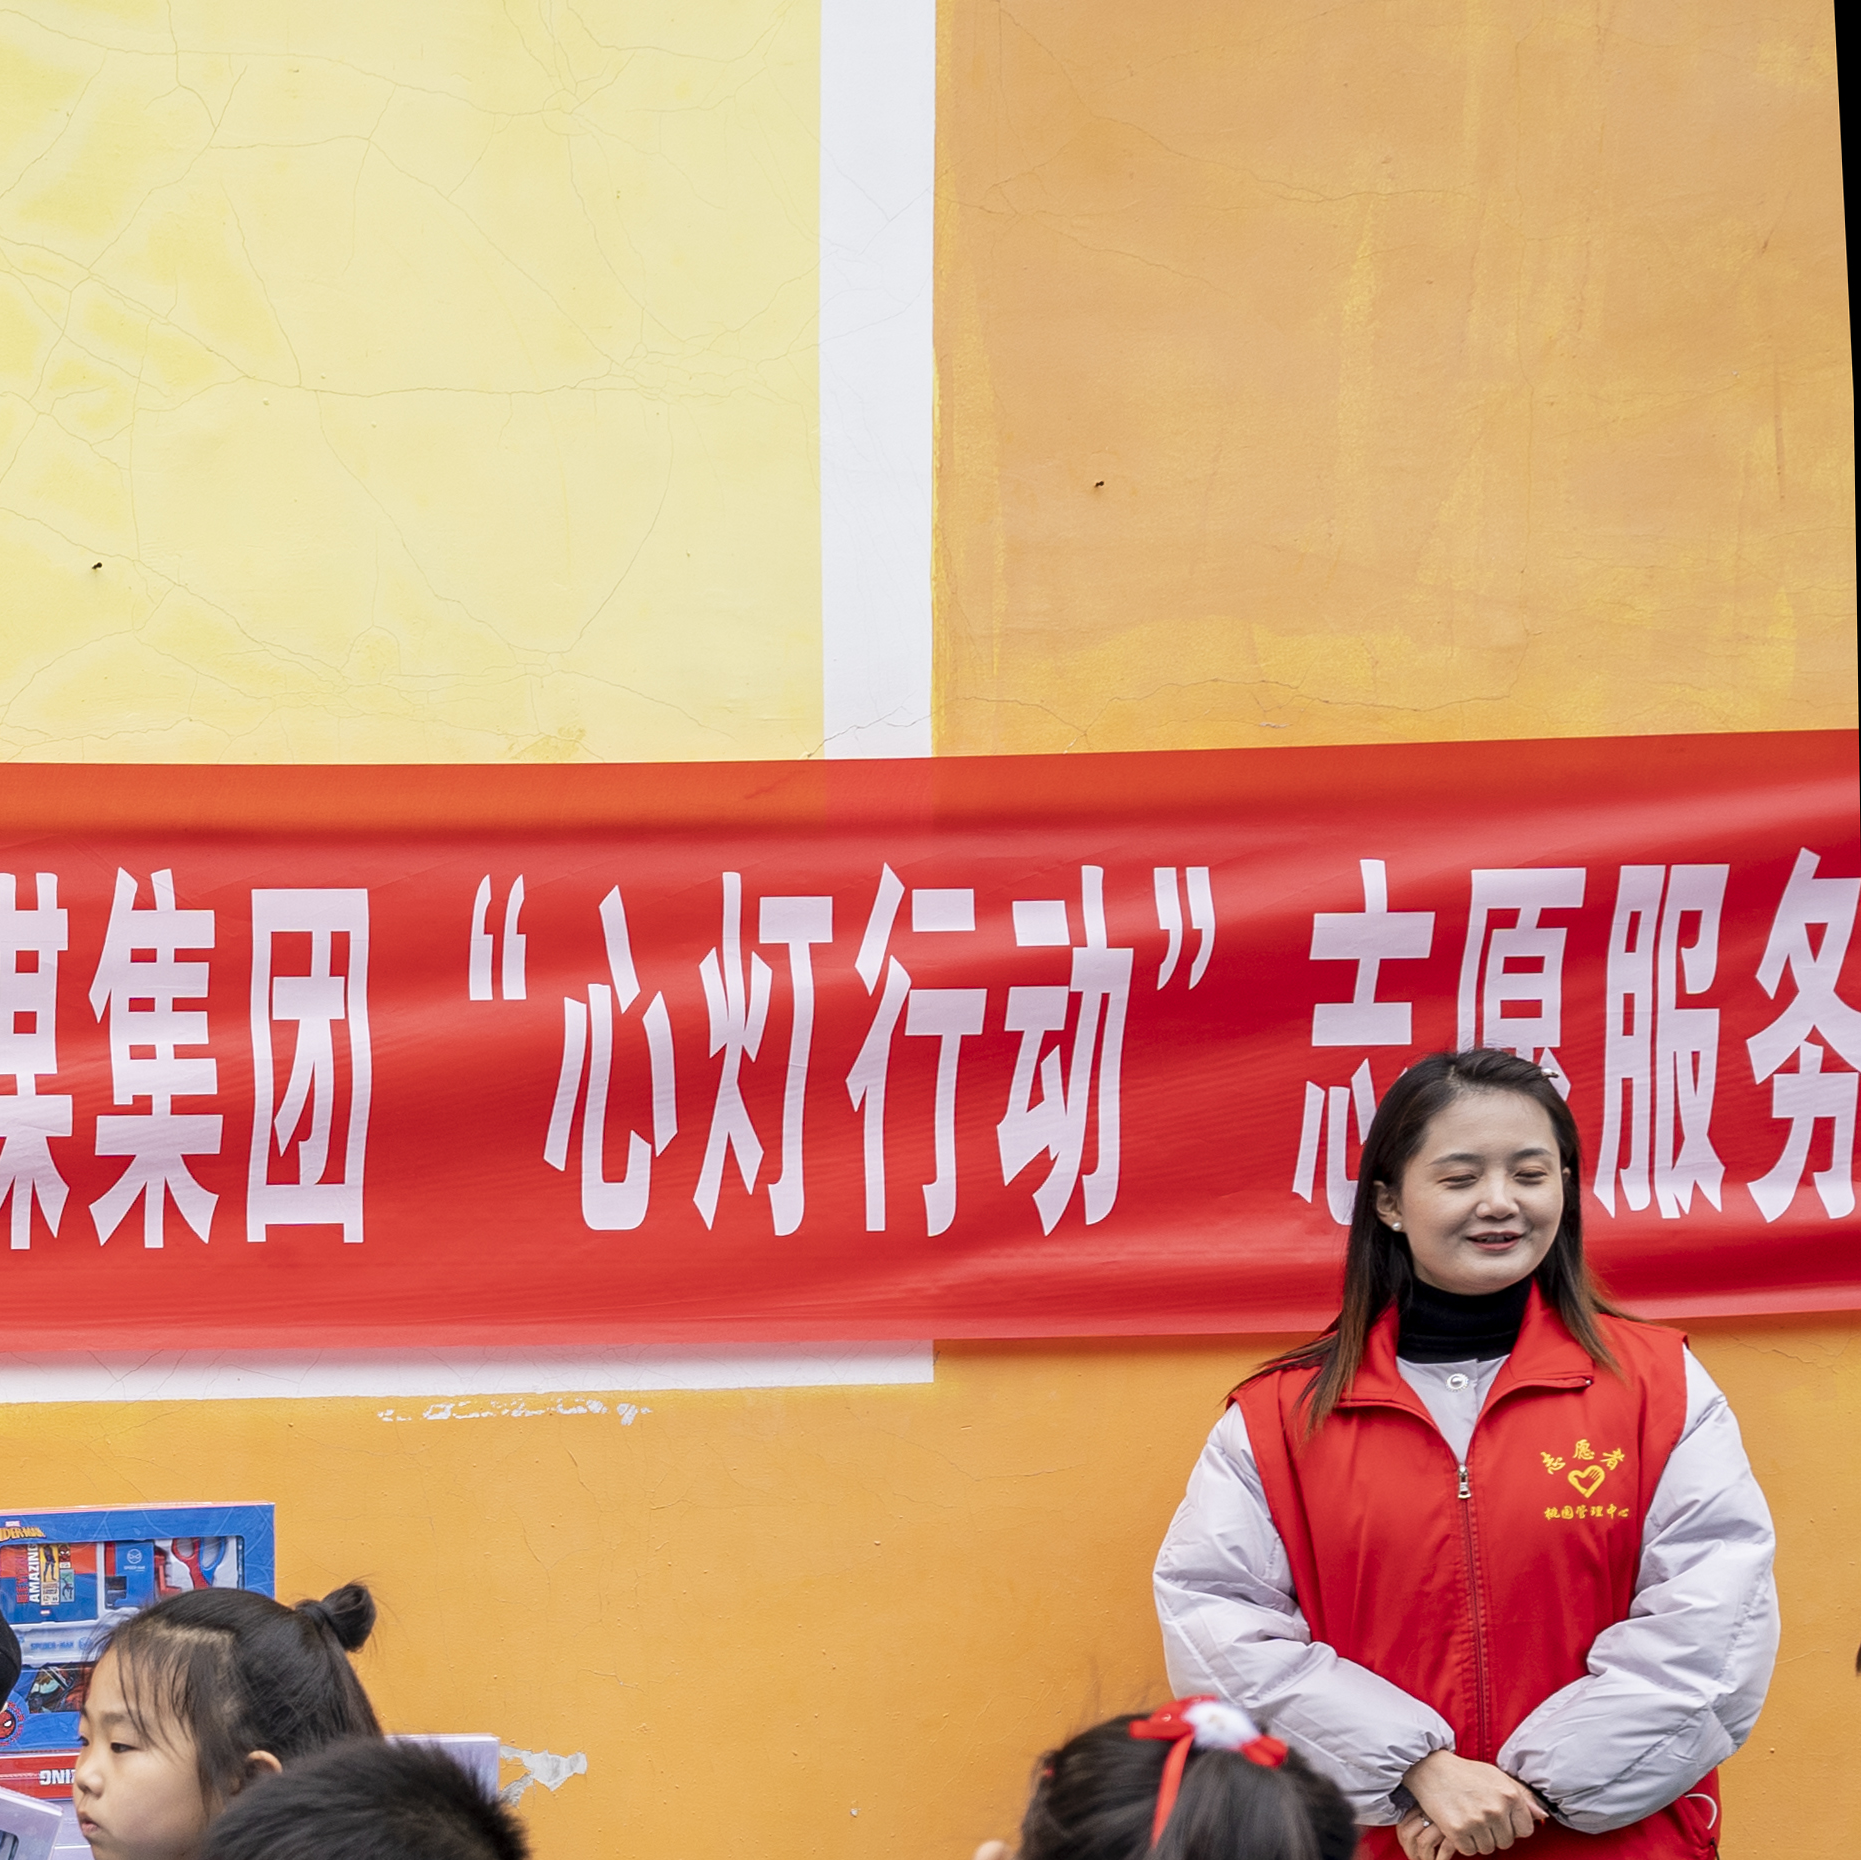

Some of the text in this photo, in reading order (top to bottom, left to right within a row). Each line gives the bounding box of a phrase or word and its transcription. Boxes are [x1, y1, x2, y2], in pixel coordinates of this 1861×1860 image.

[1540, 1438, 1626, 1475] 志愿者
[1544, 1503, 1630, 1520] 桃园管理中心
